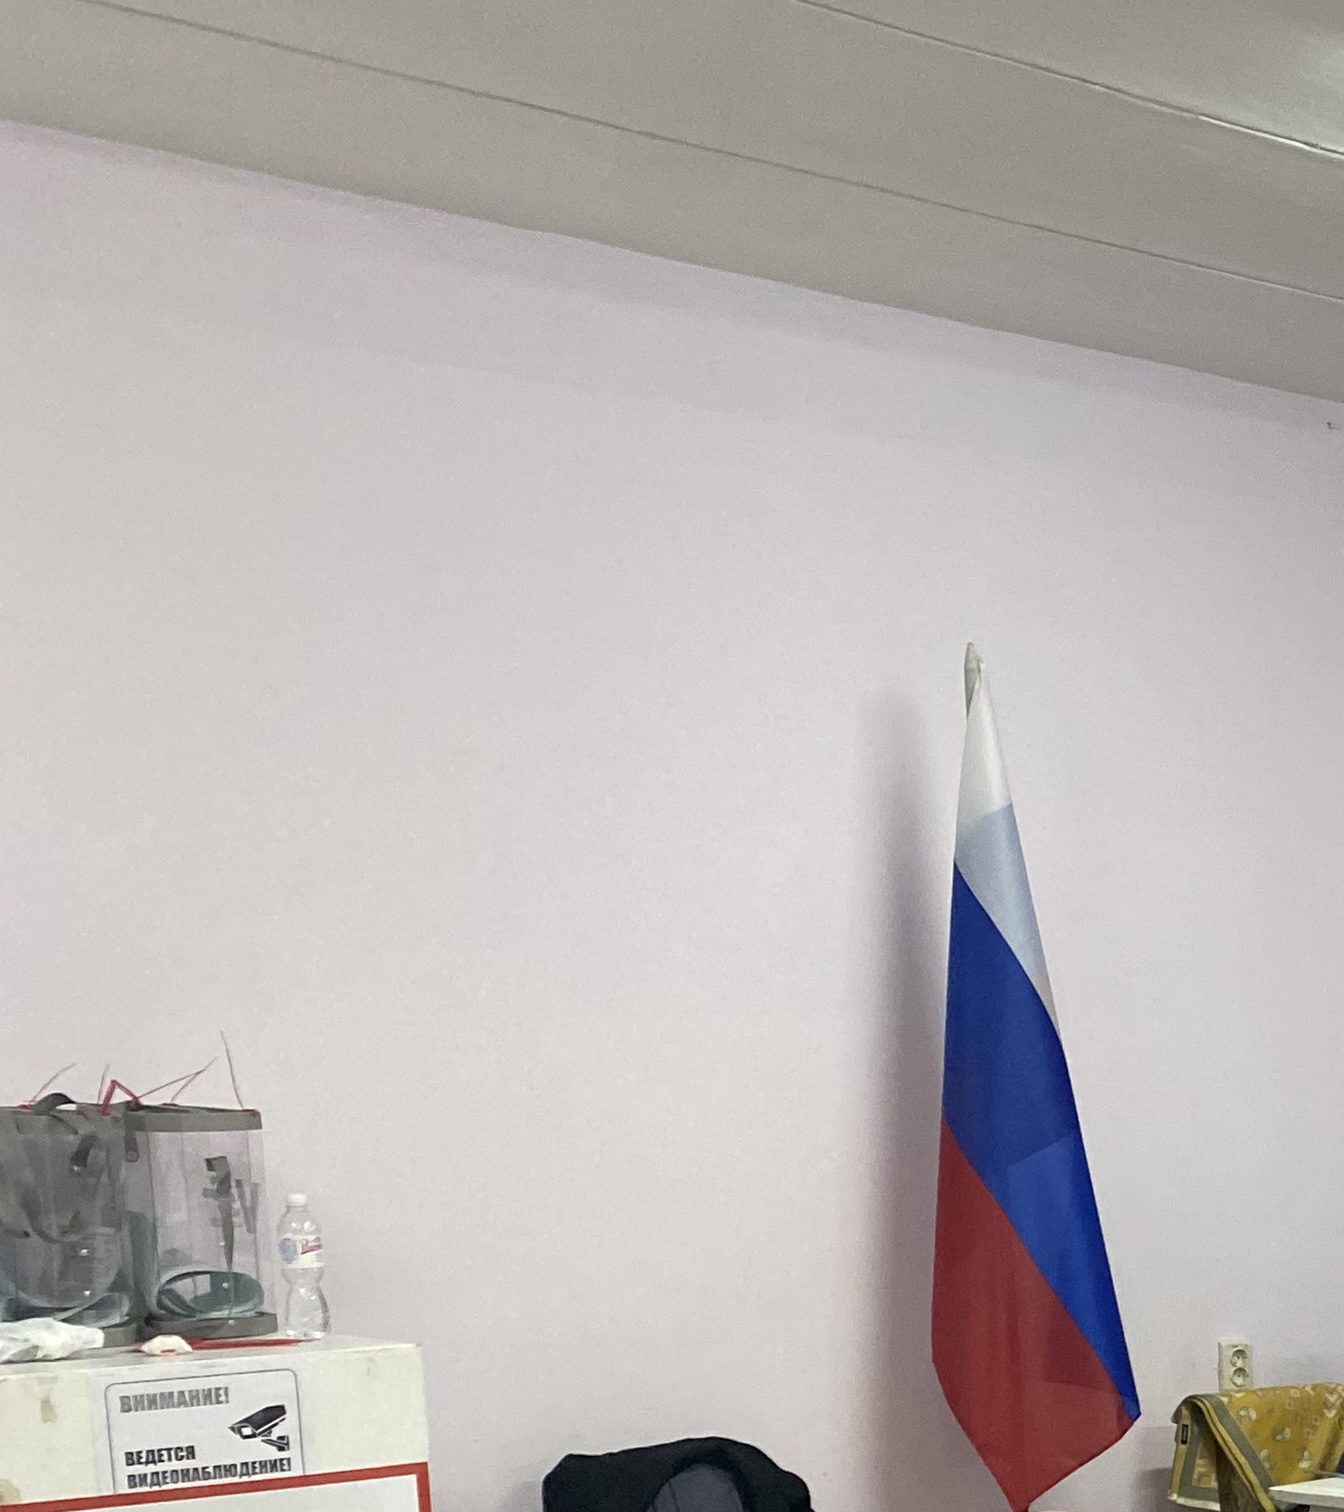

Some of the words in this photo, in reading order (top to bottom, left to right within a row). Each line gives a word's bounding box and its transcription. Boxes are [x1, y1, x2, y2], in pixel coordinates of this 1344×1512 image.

[119, 1386, 231, 1414] ВНИМАНИЕ!
[124, 1444, 196, 1467] ВЕДЕТСЯ
[126, 1457, 292, 1490] ВИДЕОНАБЛЮДЕНИЕ!
